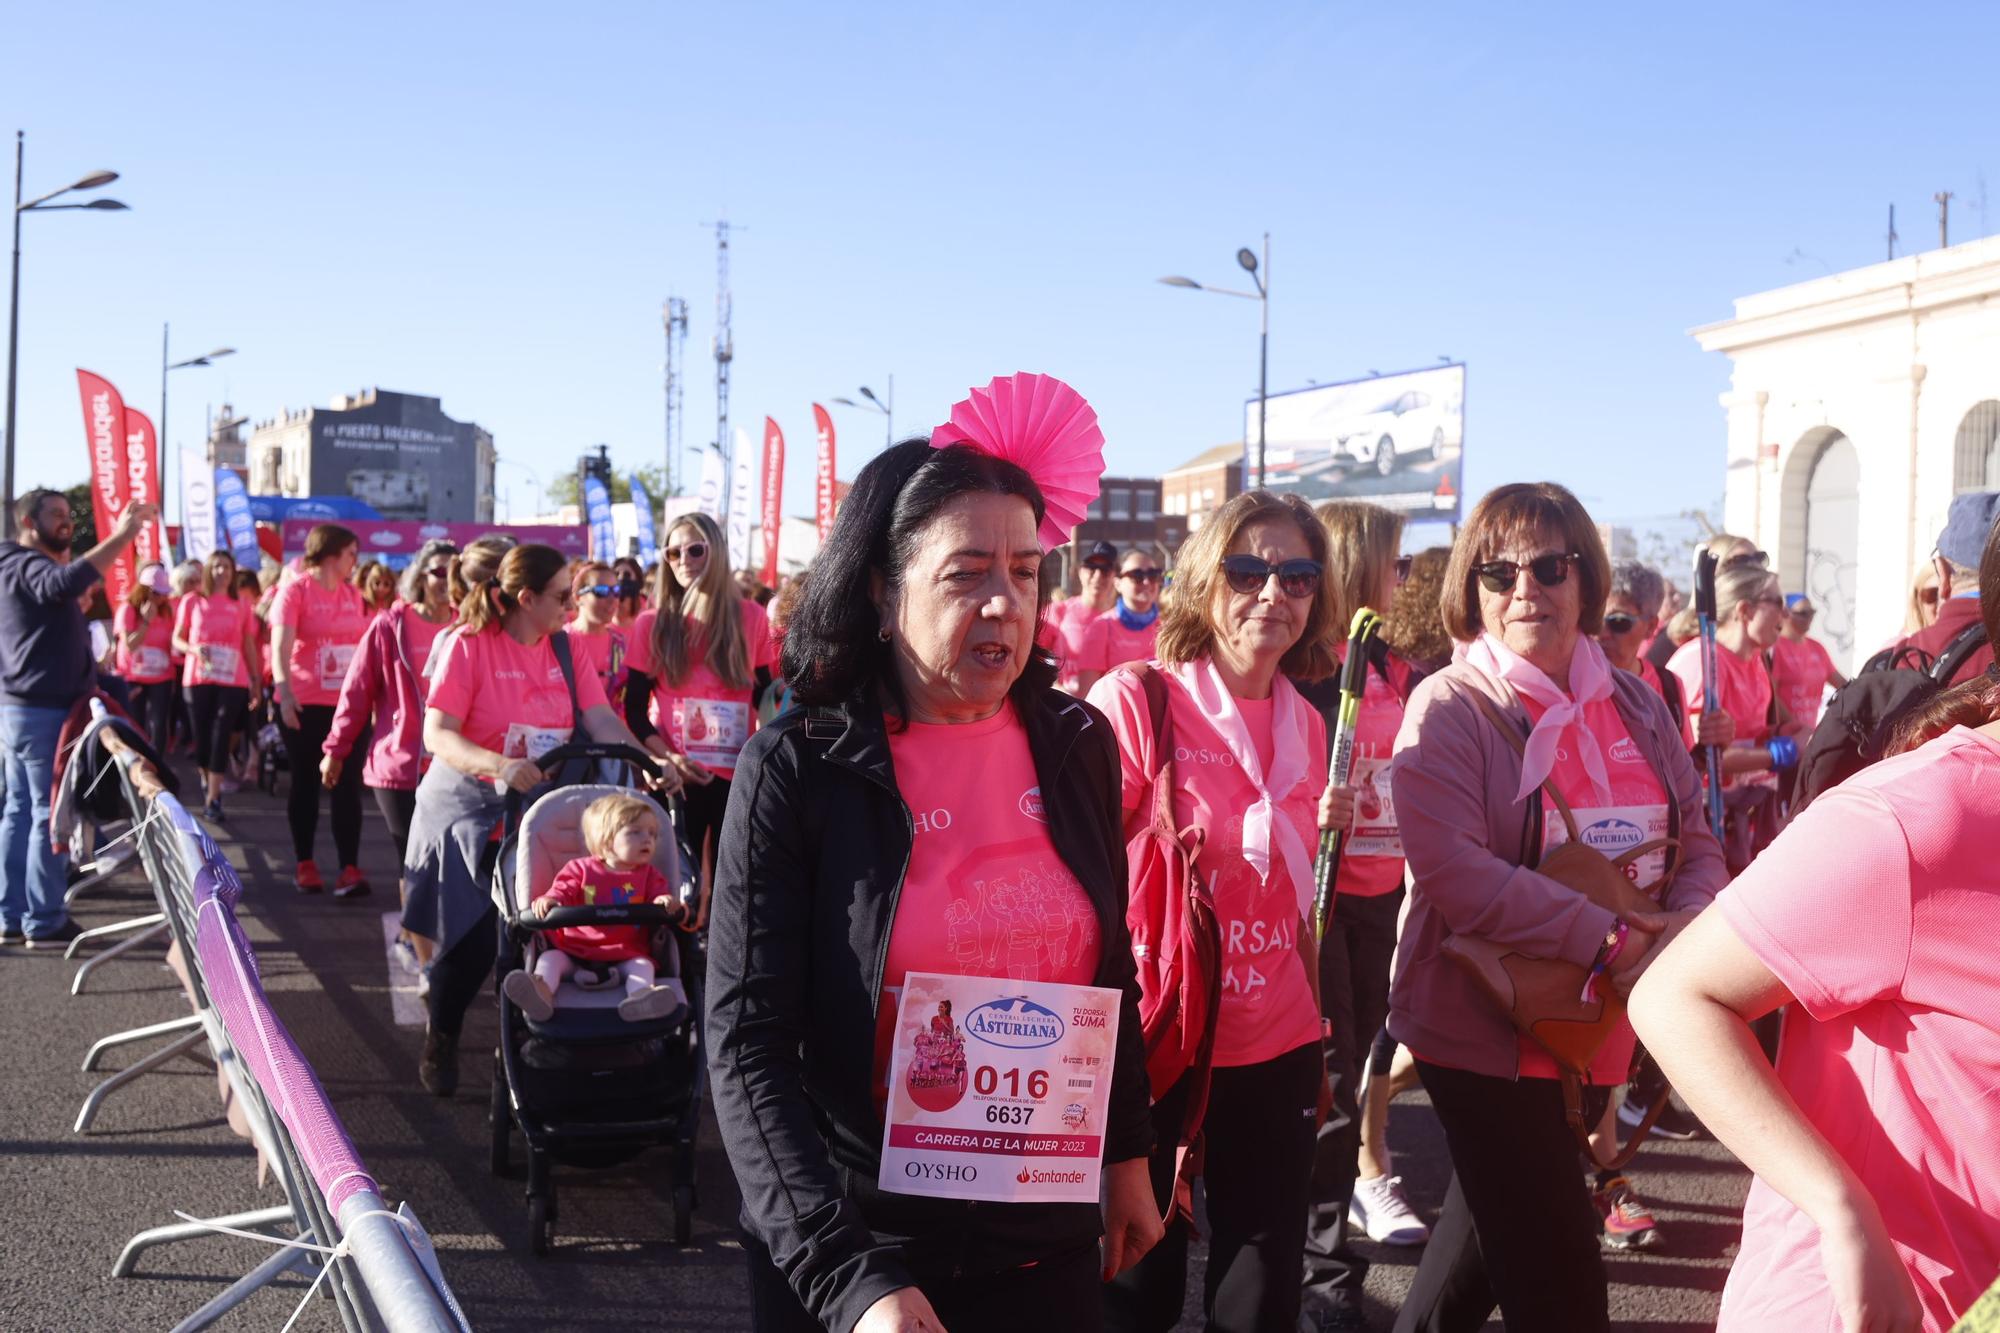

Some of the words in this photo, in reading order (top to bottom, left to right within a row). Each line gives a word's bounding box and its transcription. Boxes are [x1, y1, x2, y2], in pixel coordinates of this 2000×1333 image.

[1586, 832, 1639, 843] ASTURIANA
[1072, 1015, 1106, 1028] SUMA
[1082, 1008, 1107, 1016] DORSAL
[973, 1013, 1057, 1038] ASTURIANA
[974, 1065, 1049, 1099] 016
[986, 1105, 1034, 1125] 6637
[915, 1132, 978, 1147] CARRERA
[982, 1137, 1000, 1149] DE
[1004, 1138, 1020, 1150] LA
[1023, 1140, 1058, 1151] MUJER
[1062, 1141, 1085, 1151] 2023
[905, 1161, 977, 1182] OYSHO
[1032, 1169, 1086, 1183] Santander
